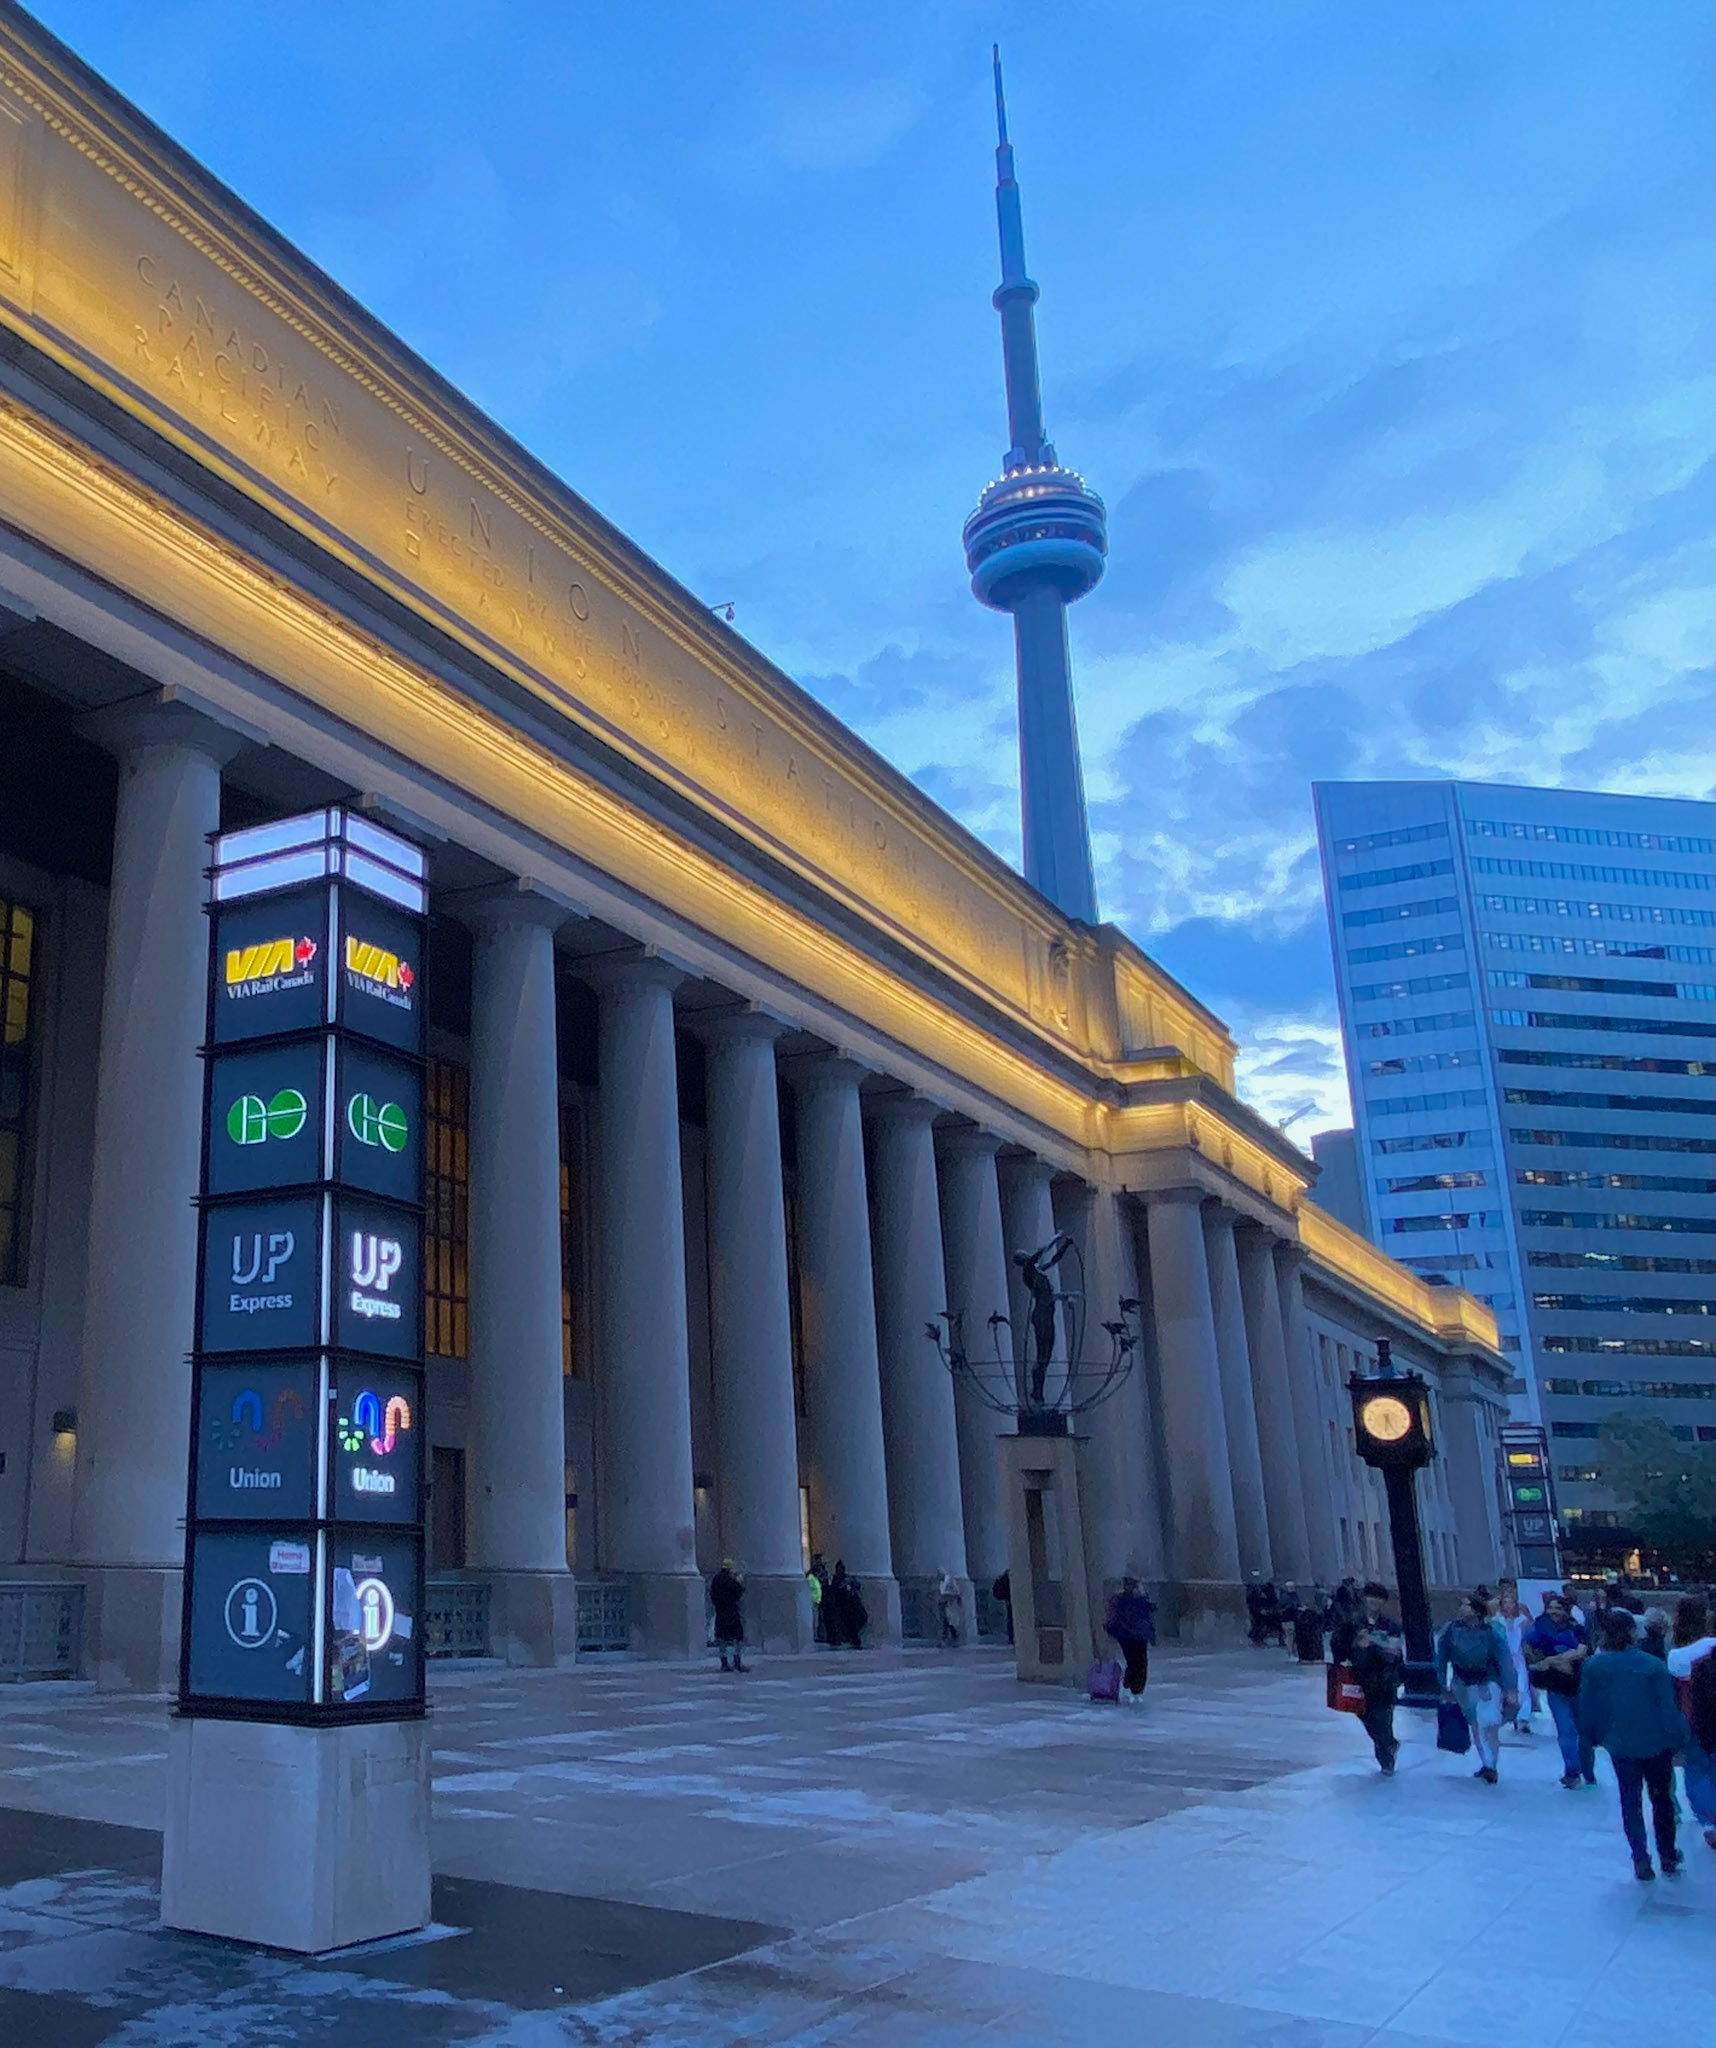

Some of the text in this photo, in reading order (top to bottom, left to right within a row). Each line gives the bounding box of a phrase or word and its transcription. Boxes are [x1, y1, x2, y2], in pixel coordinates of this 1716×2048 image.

[136, 254, 340, 434] CANADIAN
[157, 304, 320, 451] PACIFIC
[133, 323, 338, 495] RAILWAY
[405, 498, 505, 588] ERECTED
[405, 445, 641, 665] UNION
[715, 696, 918, 875] STATION
[226, 938, 294, 984] VIA
[227, 971, 315, 999] VIA Rail Canada
[346, 936, 399, 988] VIA
[347, 972, 412, 1011] VIA Rail Canada
[231, 1231, 294, 1285] UP
[352, 1232, 402, 1290] UP
[230, 1293, 293, 1314] Express
[351, 1292, 402, 1318] Express
[229, 1467, 281, 1489] Union
[353, 1468, 395, 1493] Union
